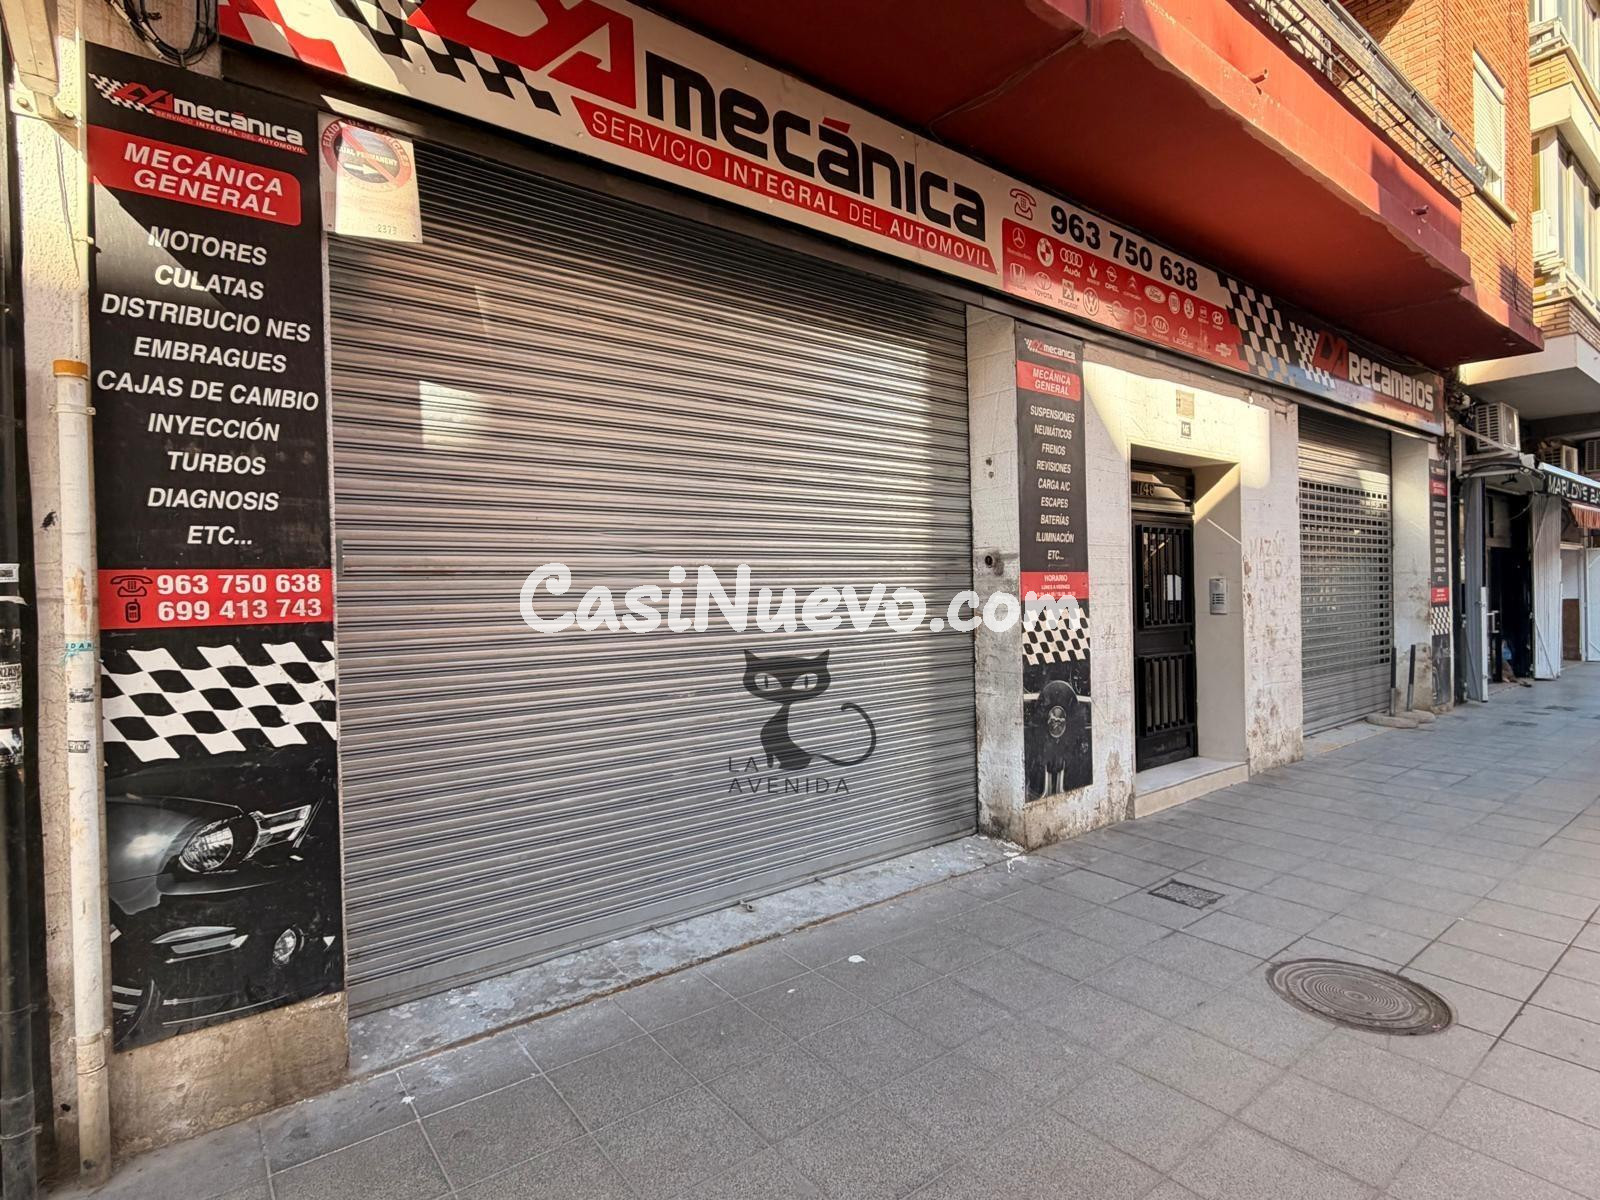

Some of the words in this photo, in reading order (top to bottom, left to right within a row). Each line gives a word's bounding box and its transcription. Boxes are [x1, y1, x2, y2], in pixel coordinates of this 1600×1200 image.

[156, 111, 196, 125] SERVICIO
[196, 121, 238, 137] INTEGRAL
[241, 131, 257, 141] DEL
[258, 138, 304, 153] AUTOMOVIL
[124, 142, 284, 196] MECÁNICA
[134, 169, 277, 216] GENERAL
[593, 111, 712, 170] SERVICIO
[724, 157, 839, 215] INTEGRAL
[849, 203, 882, 231] DEL
[890, 220, 989, 268] AUTOMOVIL
[148, 226, 268, 267] MOTORES
[1051, 205, 1101, 250] 963
[1109, 231, 1153, 273] 750
[1160, 255, 1198, 292] 638
[155, 264, 265, 300] CULATAS
[133, 336, 288, 373] EMBRAGUES
[1032, 367, 1071, 386] MECÁNICA
[97, 369, 184, 397] CAJAS
[190, 379, 225, 402] DE
[229, 384, 319, 411] CAMBIO
[1035, 380, 1070, 396] GENERAL
[1030, 404, 1075, 423] SUSPENSIONES
[148, 412, 280, 442] INYECCIÓN
[1034, 424, 1072, 440] NEUMÁTICOS
[1041, 442, 1066, 456] FRENOS
[167, 451, 267, 476] TURBOS
[1036, 459, 1072, 474] REVISIONES
[1037, 477, 1059, 491] CARGA
[147, 487, 280, 511] DIAGNOSIS
[1040, 496, 1069, 509] ESCAPES
[1040, 513, 1070, 526] BATERÍAS
[187, 525, 252, 545] ETC...
[1036, 530, 1074, 543] ILUMINACIÓN
[156, 574, 209, 595] 963
[218, 574, 267, 594] 750
[275, 573, 322, 593] 638
[1043, 574, 1068, 582] HORARIO
[158, 601, 210, 622] 699
[219, 599, 268, 619] 413
[276, 598, 322, 618] 743
[728, 756, 759, 772] LA
[728, 777, 850, 794] AVENIDA
